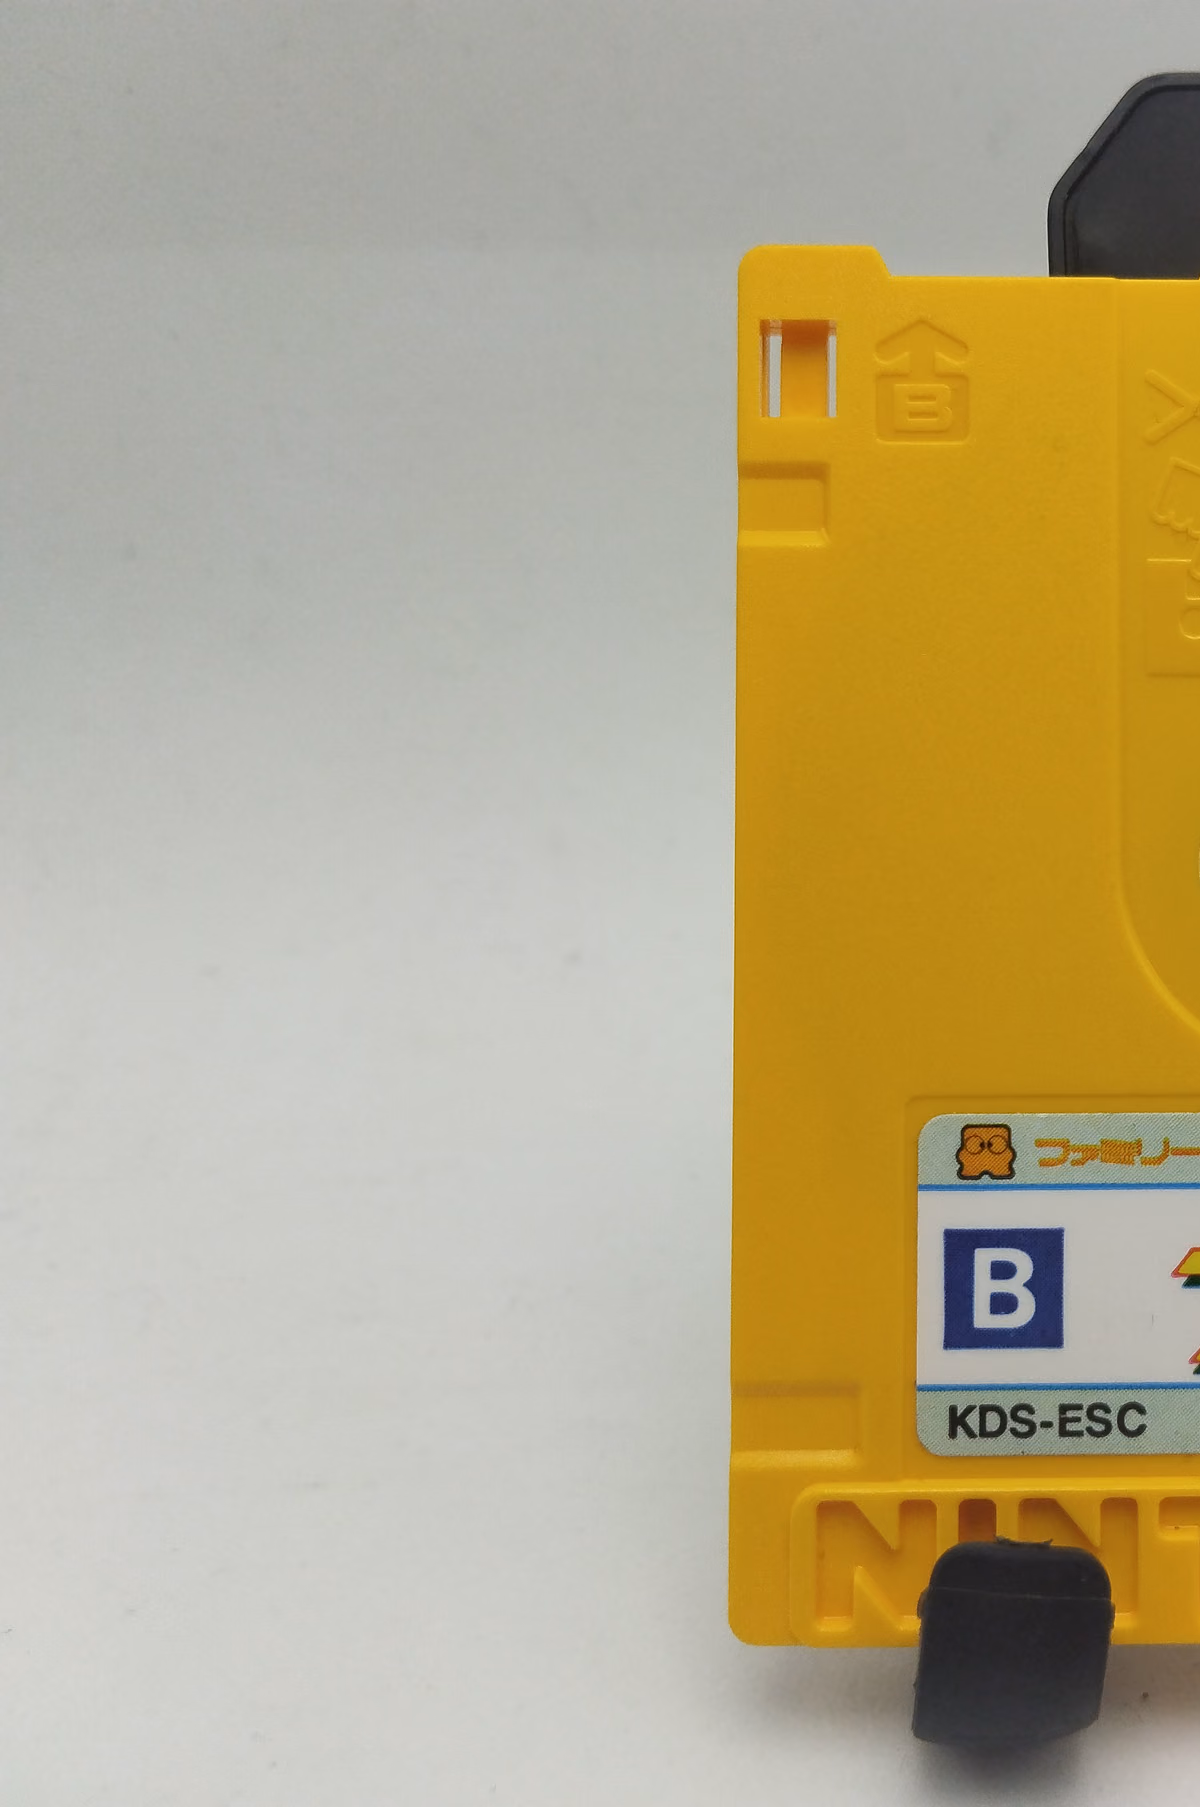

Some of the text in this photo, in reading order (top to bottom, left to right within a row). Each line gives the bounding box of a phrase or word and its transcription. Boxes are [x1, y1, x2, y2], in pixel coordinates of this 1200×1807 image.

[893, 382, 953, 433] B
[973, 1247, 1037, 1329] B
[947, 1402, 1148, 1440] KDS-ESC
